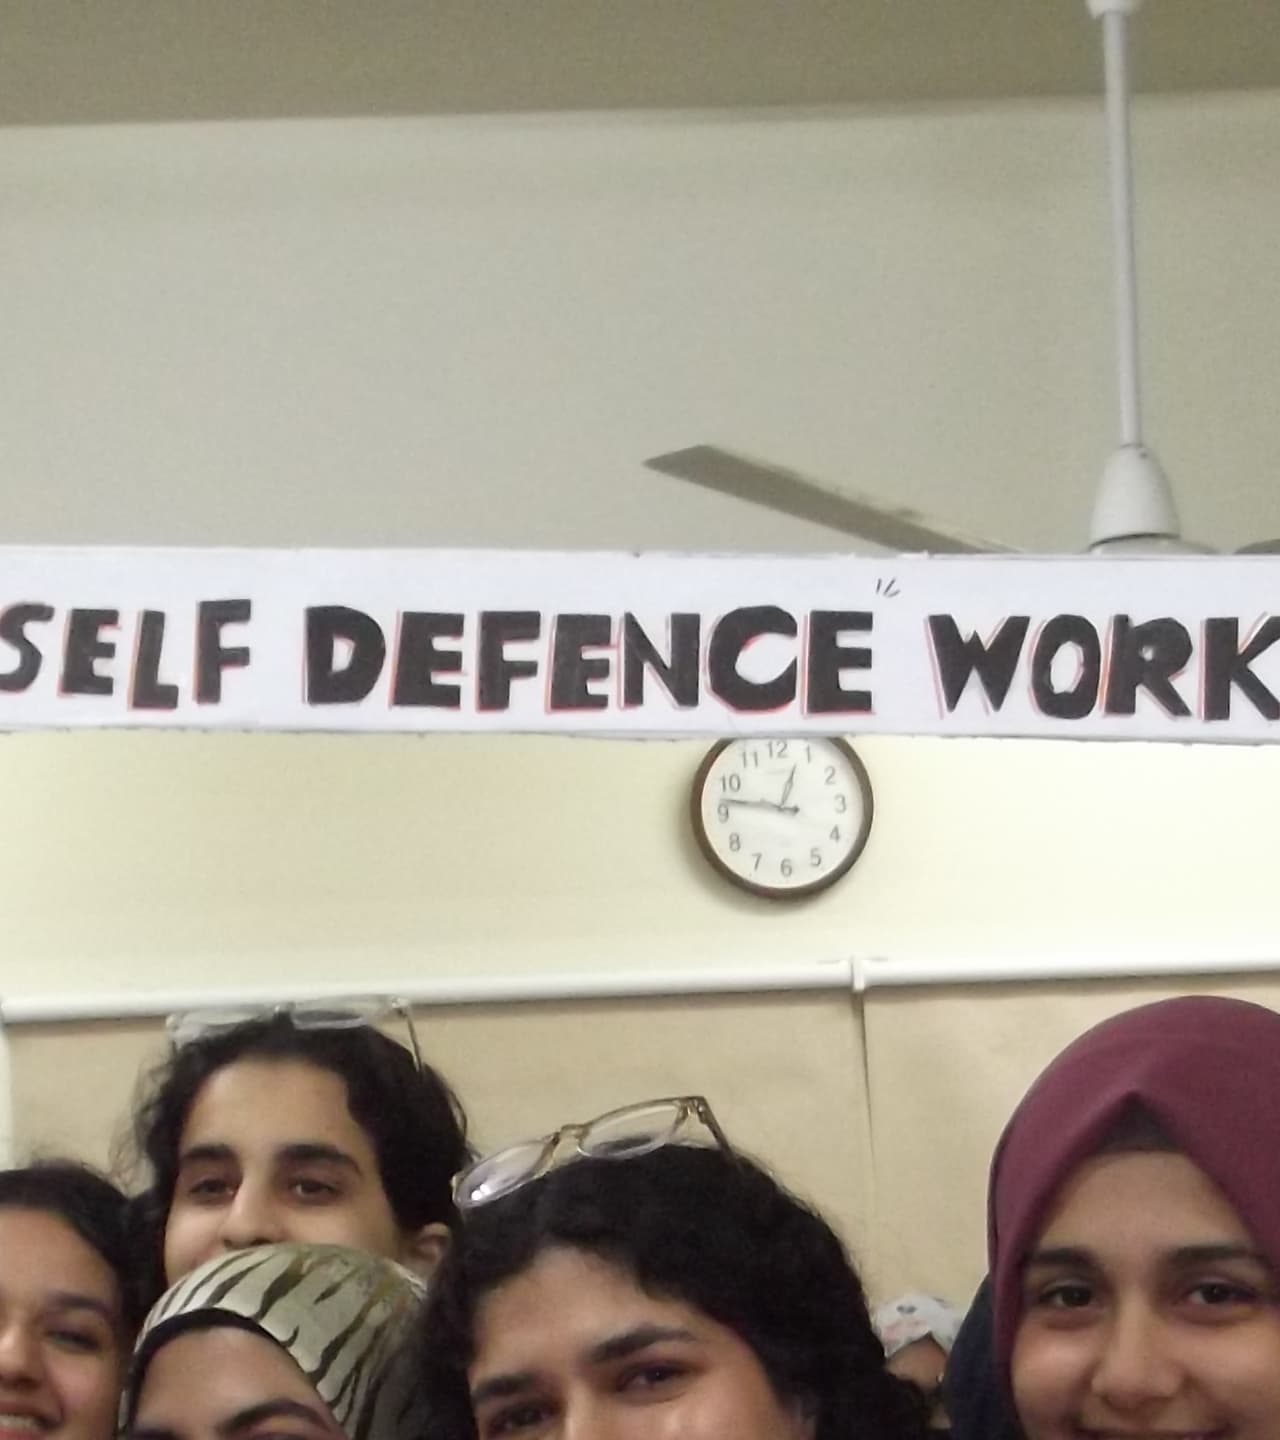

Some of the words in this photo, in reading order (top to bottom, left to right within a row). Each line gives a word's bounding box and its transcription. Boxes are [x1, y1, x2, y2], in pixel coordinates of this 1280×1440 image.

[767, 740, 788, 759] 12
[805, 744, 812, 763] 1
[741, 751, 759, 768] 11
[721, 773, 741, 793] 10
[825, 766, 836, 785] 2
[717, 804, 730, 823] 9
[834, 794, 847, 814] 3
[729, 833, 741, 852] 8
[829, 825, 841, 843] 4
[752, 853, 763, 871] 7
[810, 848, 822, 867] 5
[780, 859, 793, 877] 6
